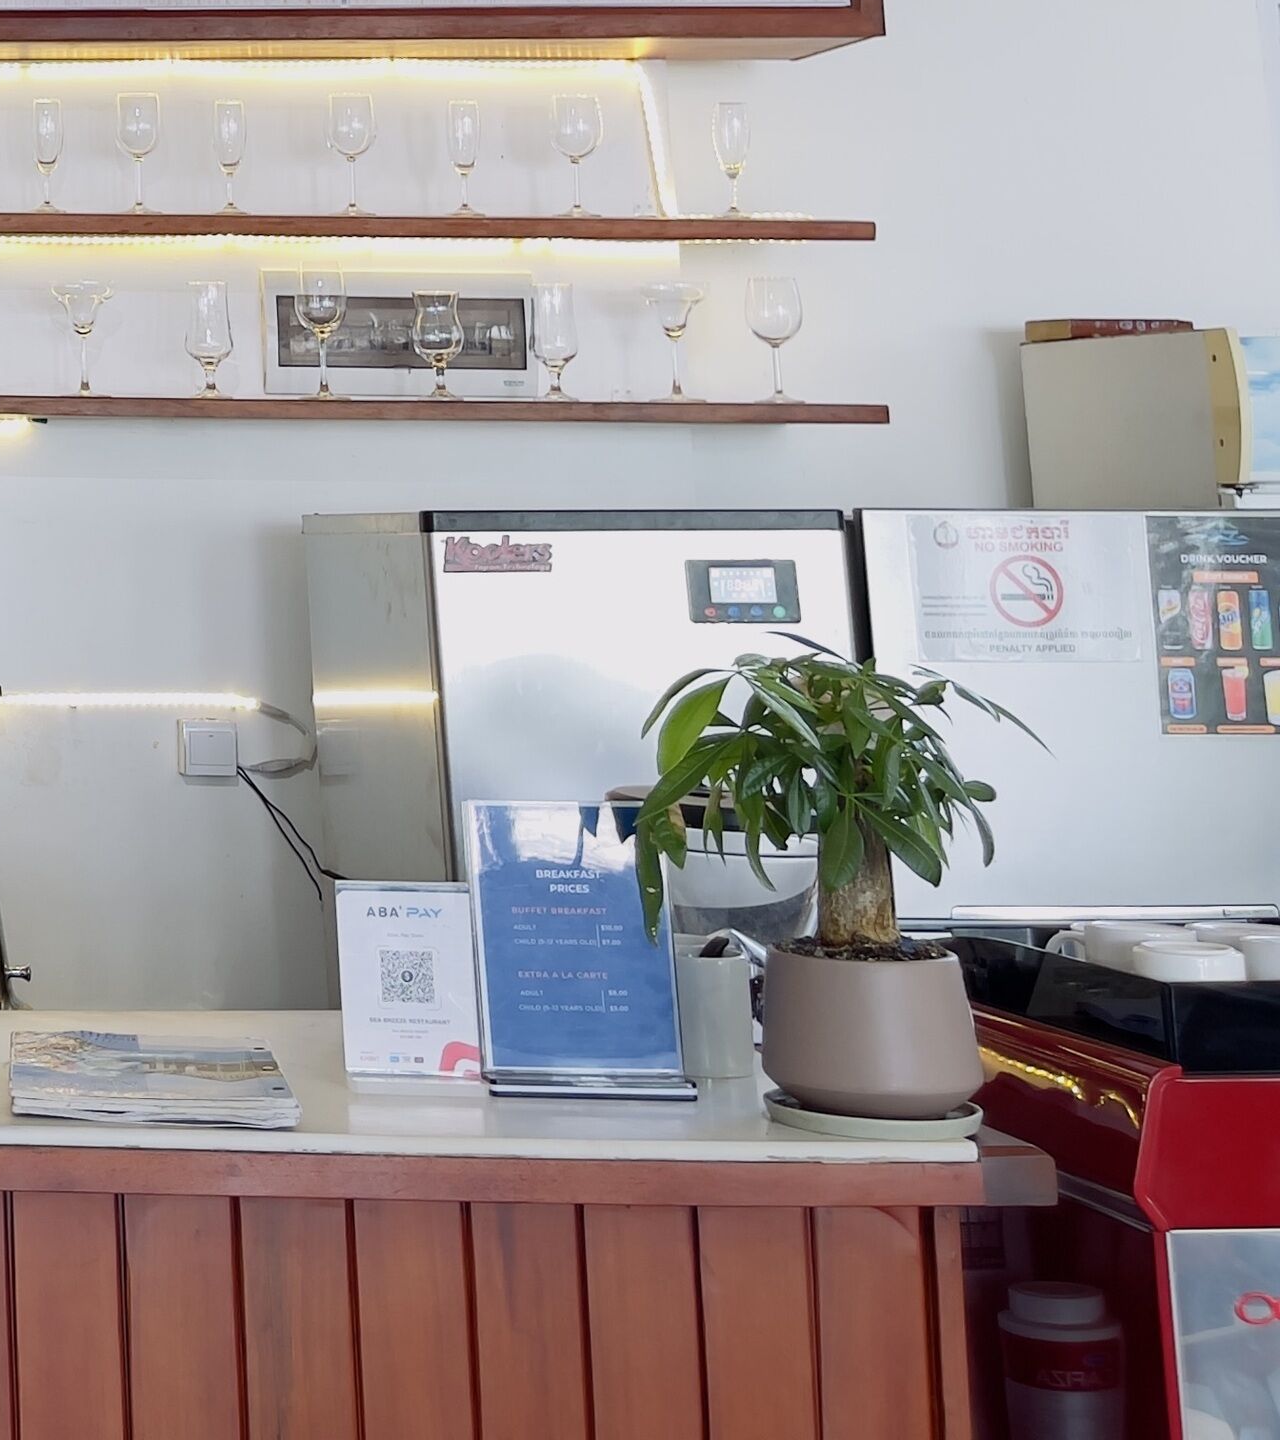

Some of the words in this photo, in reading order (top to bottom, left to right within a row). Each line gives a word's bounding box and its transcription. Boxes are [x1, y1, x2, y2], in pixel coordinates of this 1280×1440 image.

[974, 541, 995, 553] NO
[999, 541, 1064, 553] SMOKING
[1216, 554, 1268, 564] VOUCHER
[990, 644, 1032, 653] PENALTY
[1035, 644, 1076, 653] APPLIED
[535, 869, 601, 879] BREAKFAST
[549, 884, 590, 894] PRICES
[406, 907, 442, 919] PAY
[511, 906, 547, 914] BUFFET
[550, 906, 607, 915] BREAKFAST
[518, 971, 549, 979] EXTRA
[577, 971, 608, 979] CARTE
